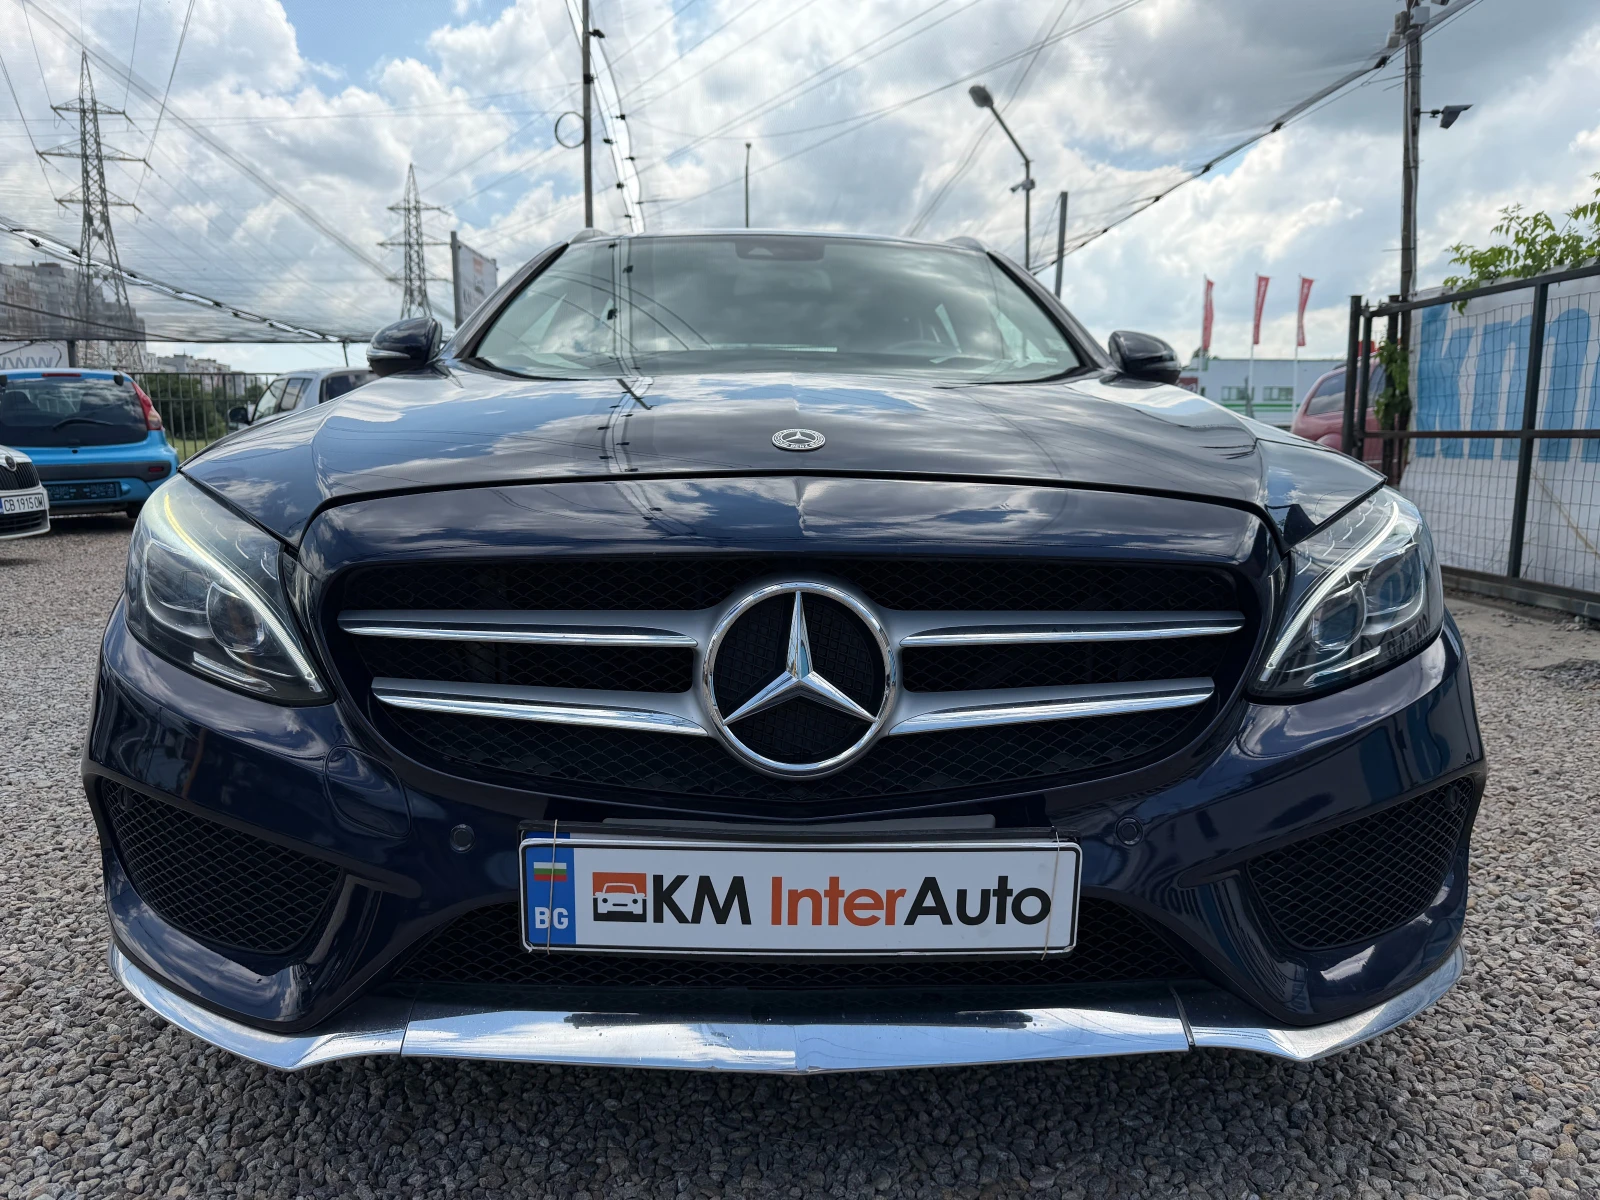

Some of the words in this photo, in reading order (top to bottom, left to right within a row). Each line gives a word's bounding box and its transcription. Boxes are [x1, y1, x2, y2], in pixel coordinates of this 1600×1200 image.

[1416, 303, 1600, 463] km
[17, 497, 34, 510] 1915
[534, 906, 569, 930] BG
[652, 874, 752, 925] KM
[771, 875, 1051, 926] InterAuto
